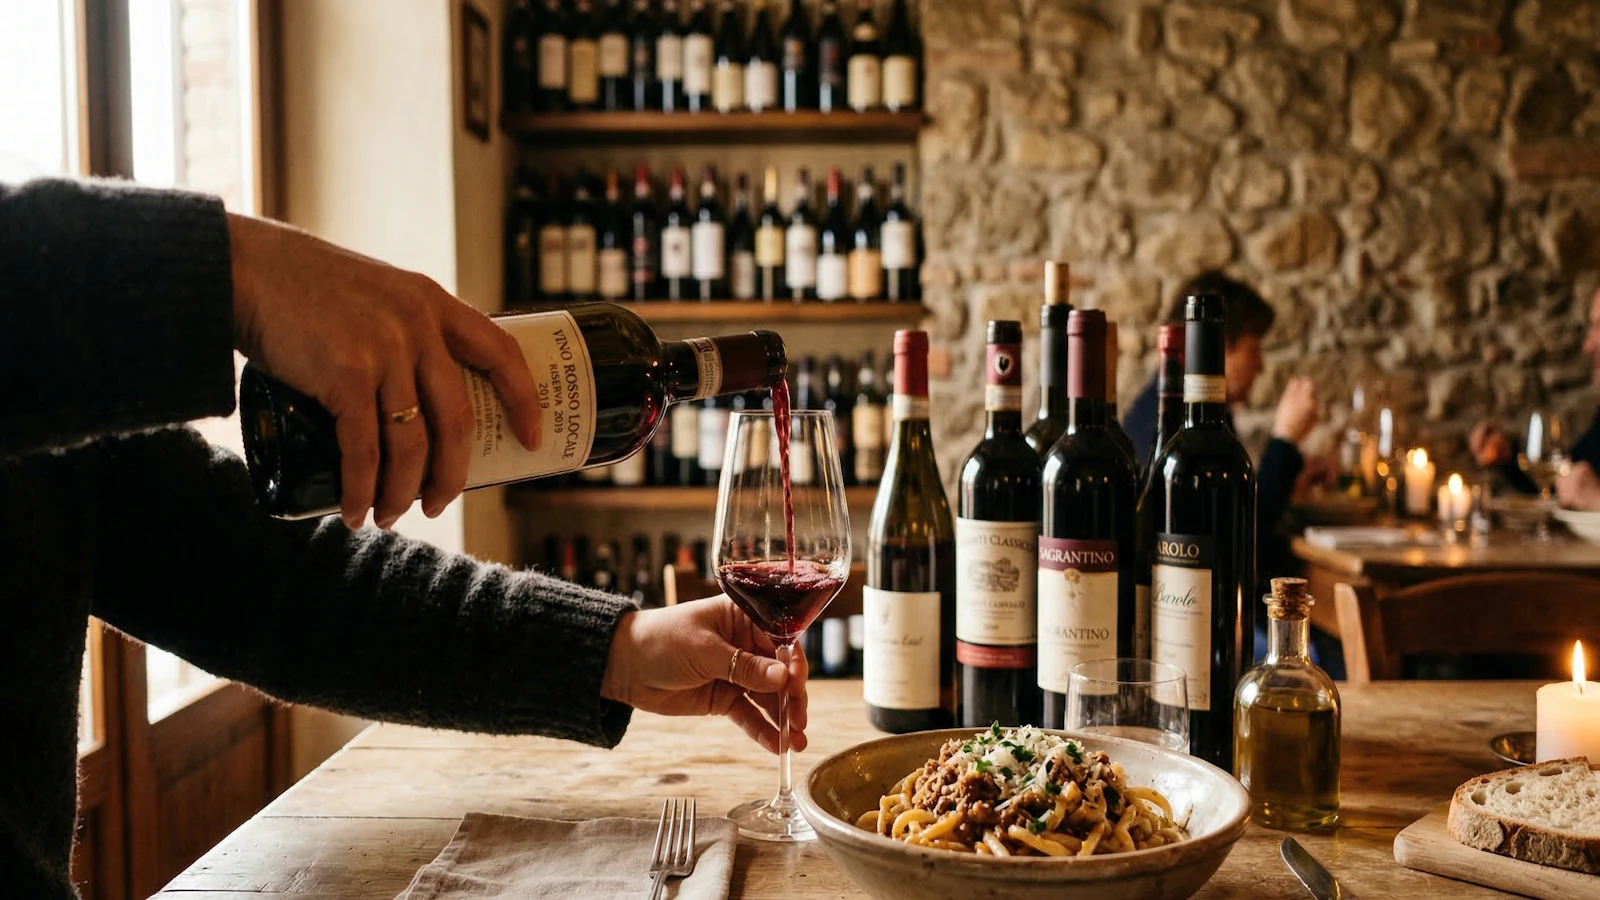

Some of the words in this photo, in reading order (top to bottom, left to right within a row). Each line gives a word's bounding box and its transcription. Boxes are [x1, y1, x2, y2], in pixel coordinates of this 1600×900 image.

[552, 329, 573, 361] VINO
[538, 382, 550, 409] 2019
[549, 363, 563, 407] RISERVA
[564, 363, 580, 411] ROSSO
[555, 411, 564, 434] 2019
[561, 414, 580, 461] LOCALE
[1039, 546, 1115, 564] SAGRANTINO
[1156, 540, 1200, 558] AROLO
[1153, 581, 1197, 608] Barolo
[1043, 625, 1110, 642] RANTINO
